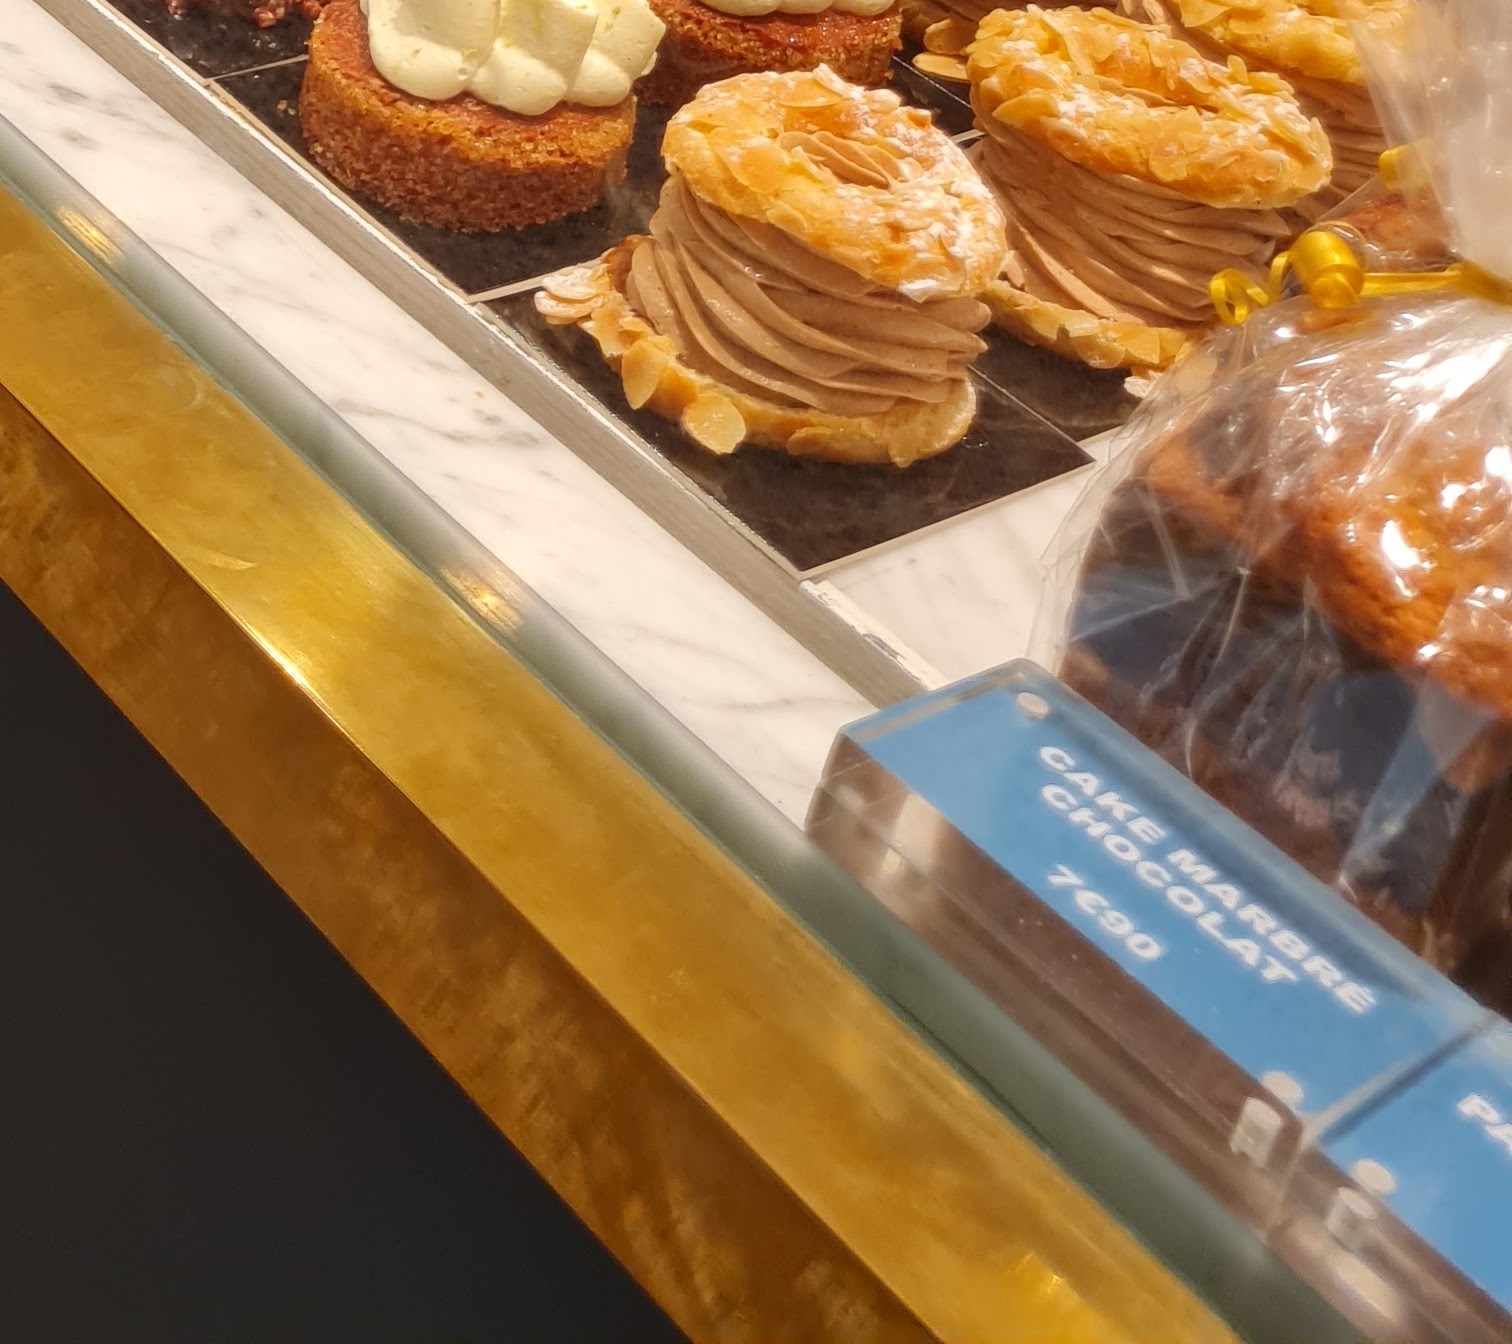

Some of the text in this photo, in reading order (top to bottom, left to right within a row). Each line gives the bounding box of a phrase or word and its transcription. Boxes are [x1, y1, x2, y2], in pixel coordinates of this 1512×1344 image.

[1037, 745, 1378, 1016] CAKE MARBRE
[1039, 784, 1297, 985] CHOCOLAT
[1048, 863, 1163, 961] 7€90
